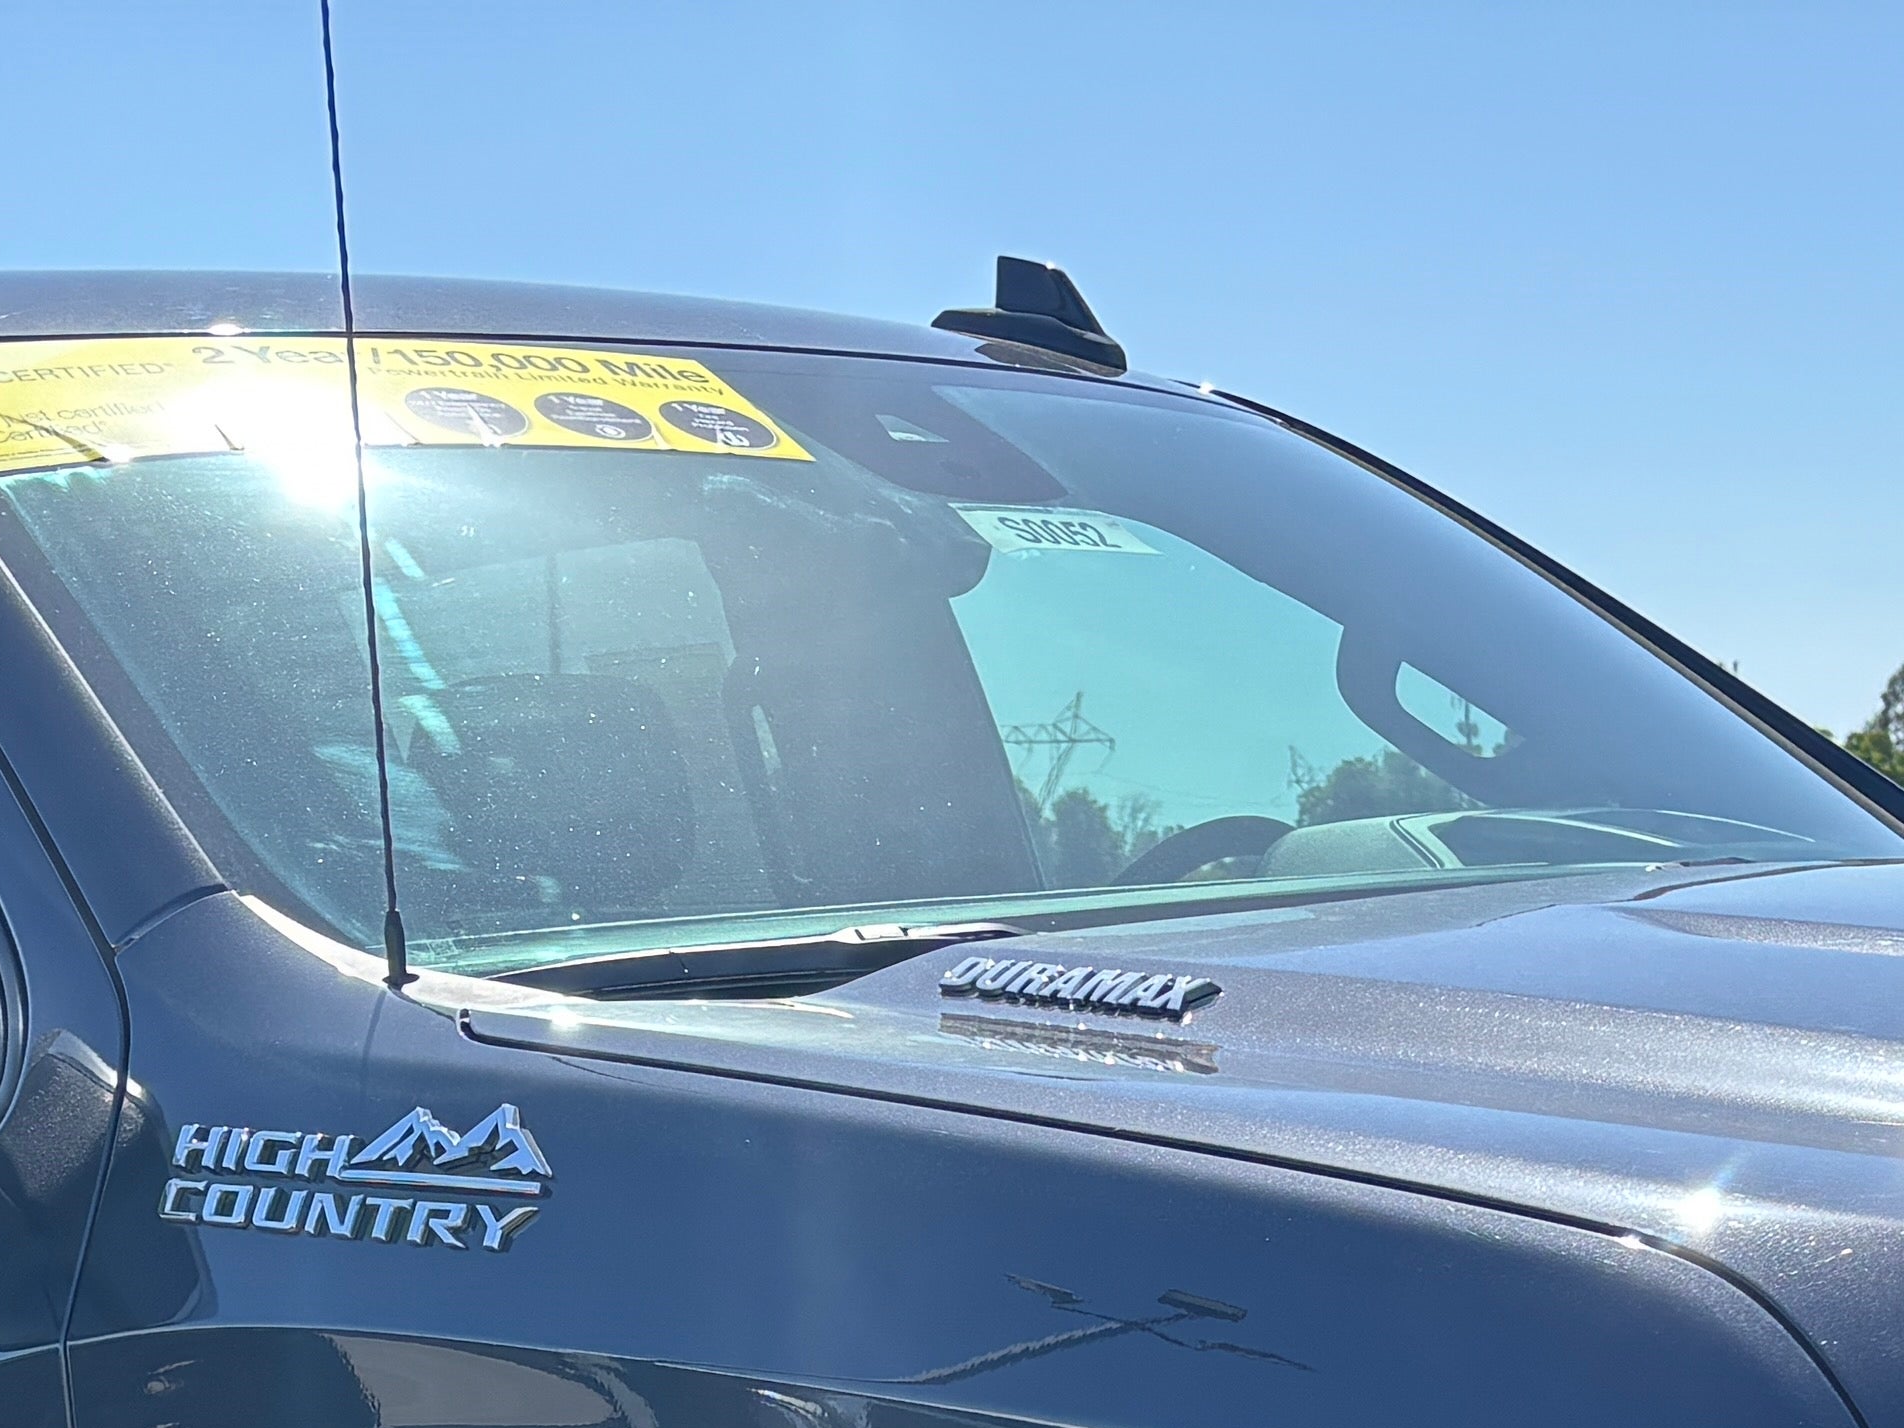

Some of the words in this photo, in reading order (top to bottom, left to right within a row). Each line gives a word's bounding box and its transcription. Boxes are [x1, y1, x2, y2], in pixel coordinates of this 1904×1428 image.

[192, 346, 236, 364] 2
[594, 358, 711, 384] Mile
[367, 366, 510, 380] Powertrain
[515, 372, 588, 386] Limited
[610, 377, 726, 397] Warranty
[997, 516, 1122, 549] S0052
[938, 956, 1224, 1023] DURAMAX
[172, 1123, 365, 1181] HIGH
[158, 1178, 540, 1252] COUNTRY
